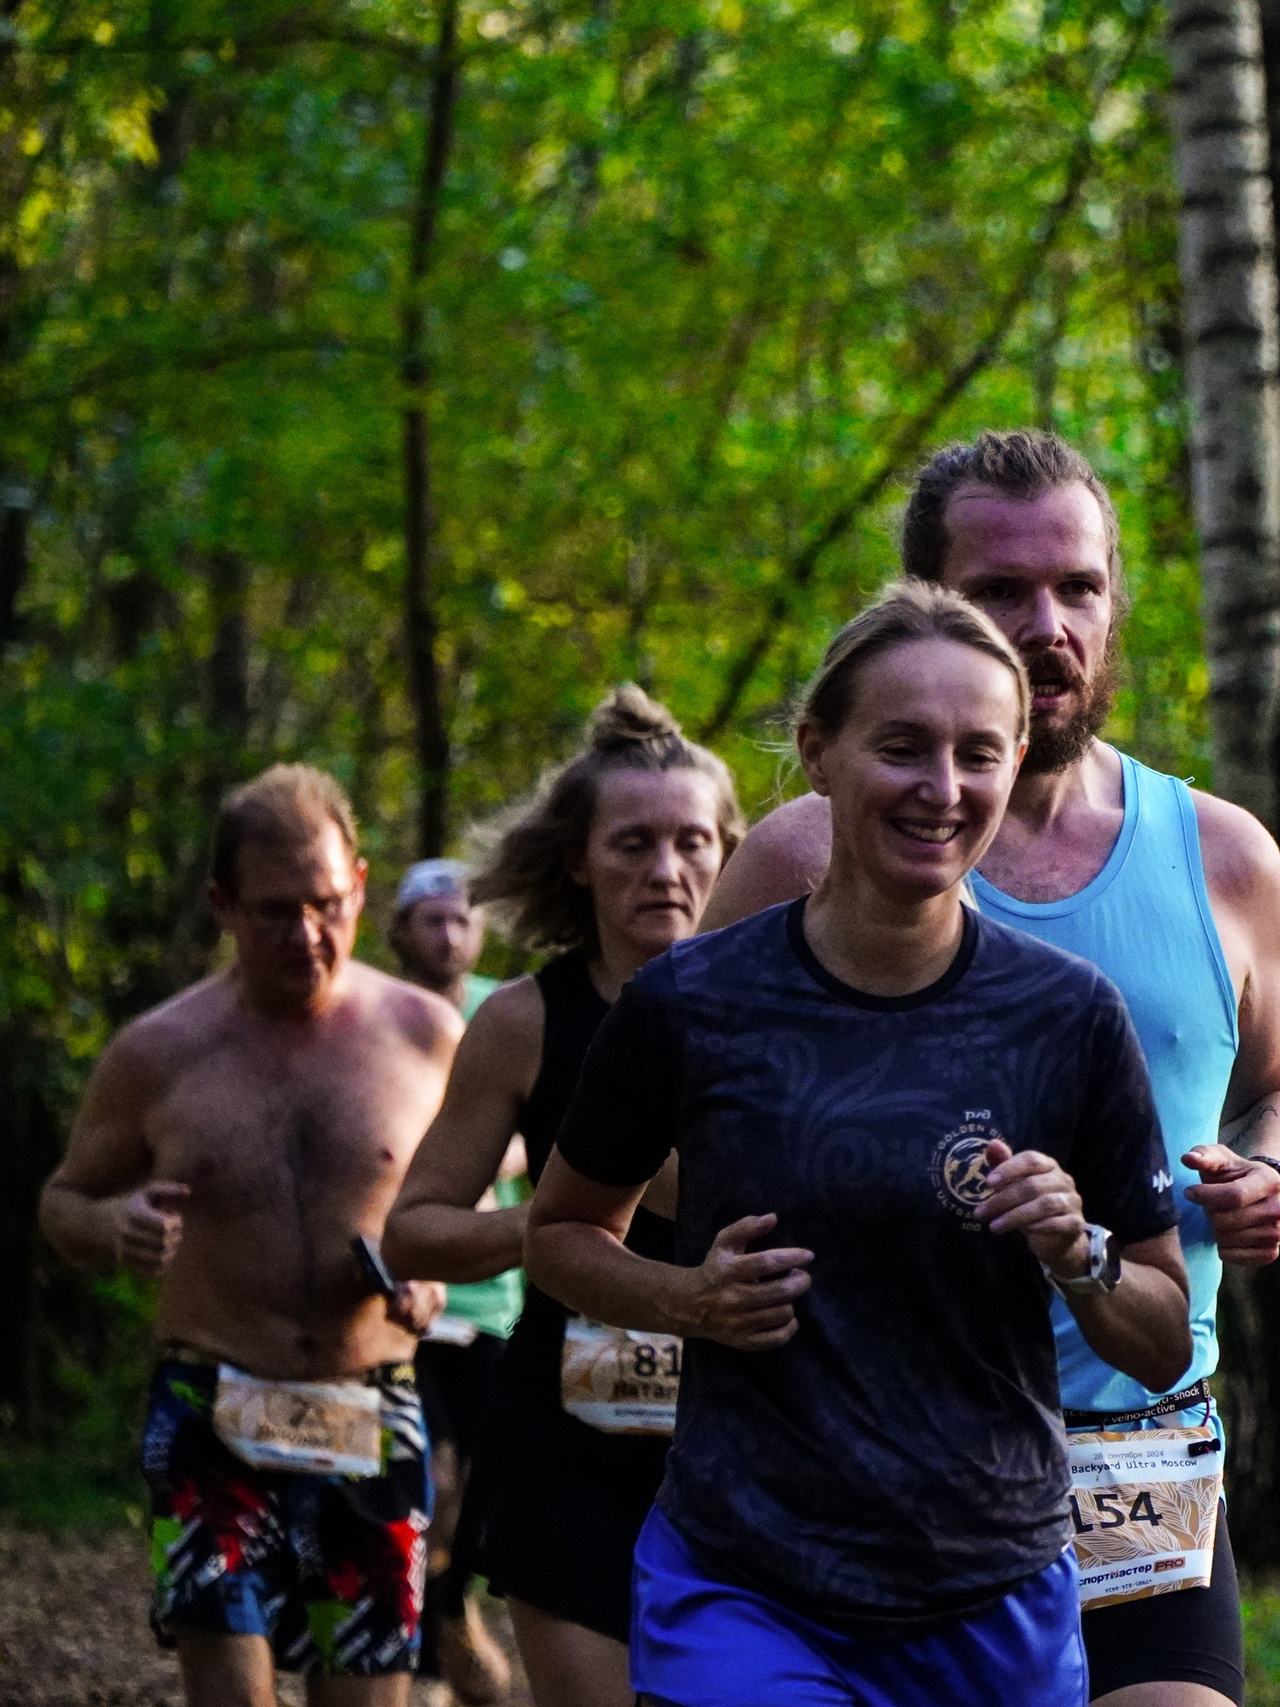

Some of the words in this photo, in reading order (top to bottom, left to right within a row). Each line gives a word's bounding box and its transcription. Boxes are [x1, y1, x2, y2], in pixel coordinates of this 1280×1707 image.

[1111, 1404, 1176, 1424] veino-active
[1146, 1450, 1164, 1458] 2024
[1126, 1461, 1157, 1469] Ultra
[1161, 1459, 1198, 1468] Moscow
[1155, 1558, 1186, 1573] PRO
